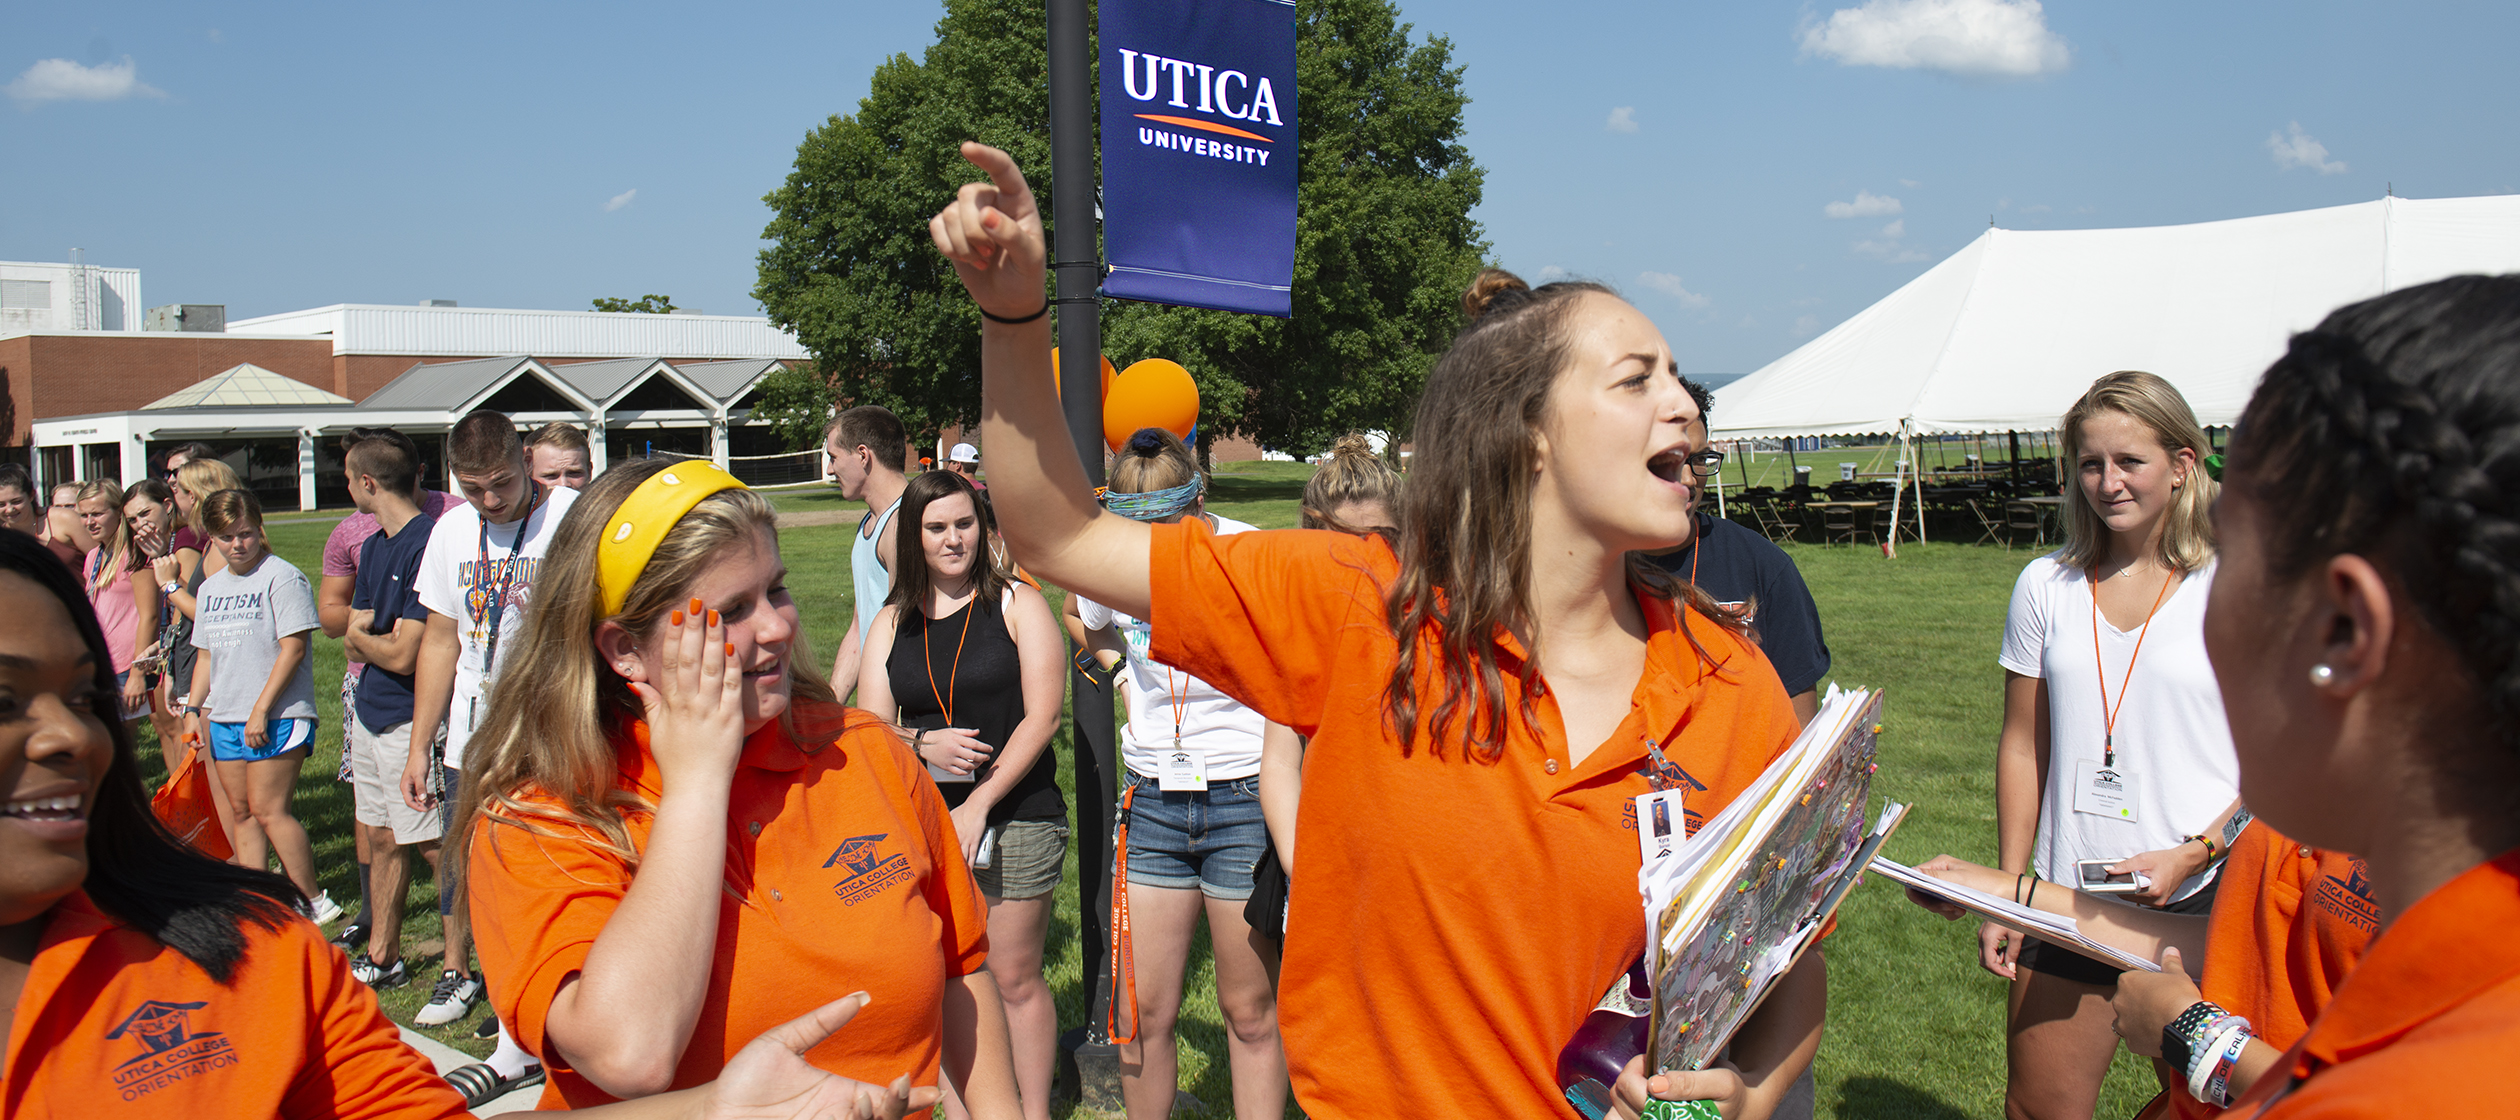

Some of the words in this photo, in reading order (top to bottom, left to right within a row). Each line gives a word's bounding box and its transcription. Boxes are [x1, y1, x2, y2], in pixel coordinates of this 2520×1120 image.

[1118, 47, 1284, 126] UTICA
[1138, 126, 1271, 167] UNIVERSITY
[482, 551, 490, 582] COLLEGE
[506, 550, 518, 573] UTICA
[497, 575, 510, 607] COLLEGE
[835, 879, 867, 897] UTICA
[866, 857, 909, 882] COLLEGE
[843, 869, 916, 907] ORIENTATION
[1121, 892, 1129, 932] COLLEGE
[2314, 893, 2380, 934] ORIENTATIO
[2319, 879, 2344, 900] UTICA
[2345, 896, 2382, 920] COLLE
[1123, 935, 1133, 980] PIONEERS
[113, 1060, 164, 1084] UTICA
[165, 1037, 231, 1063] COLLEGE
[122, 1052, 239, 1102] ORIENTATION
[2213, 1060, 2232, 1099] CHLOE
